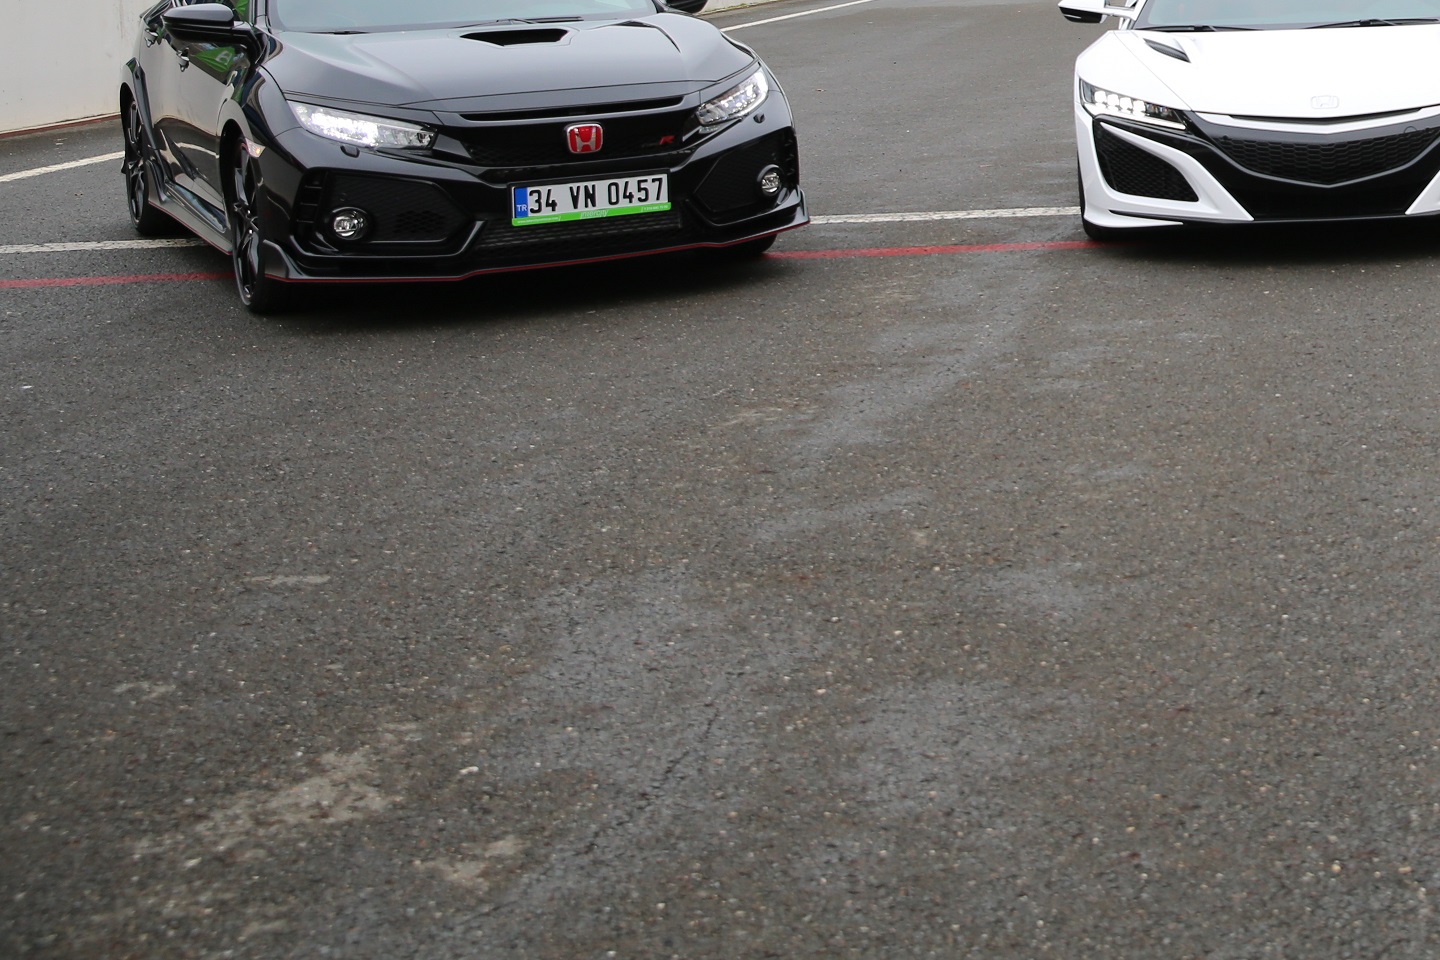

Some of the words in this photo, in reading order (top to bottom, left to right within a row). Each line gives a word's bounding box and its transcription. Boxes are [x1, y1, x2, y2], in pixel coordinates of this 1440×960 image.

[529, 189, 557, 213] 34
[569, 184, 597, 209] VN
[607, 177, 663, 205] 0457
